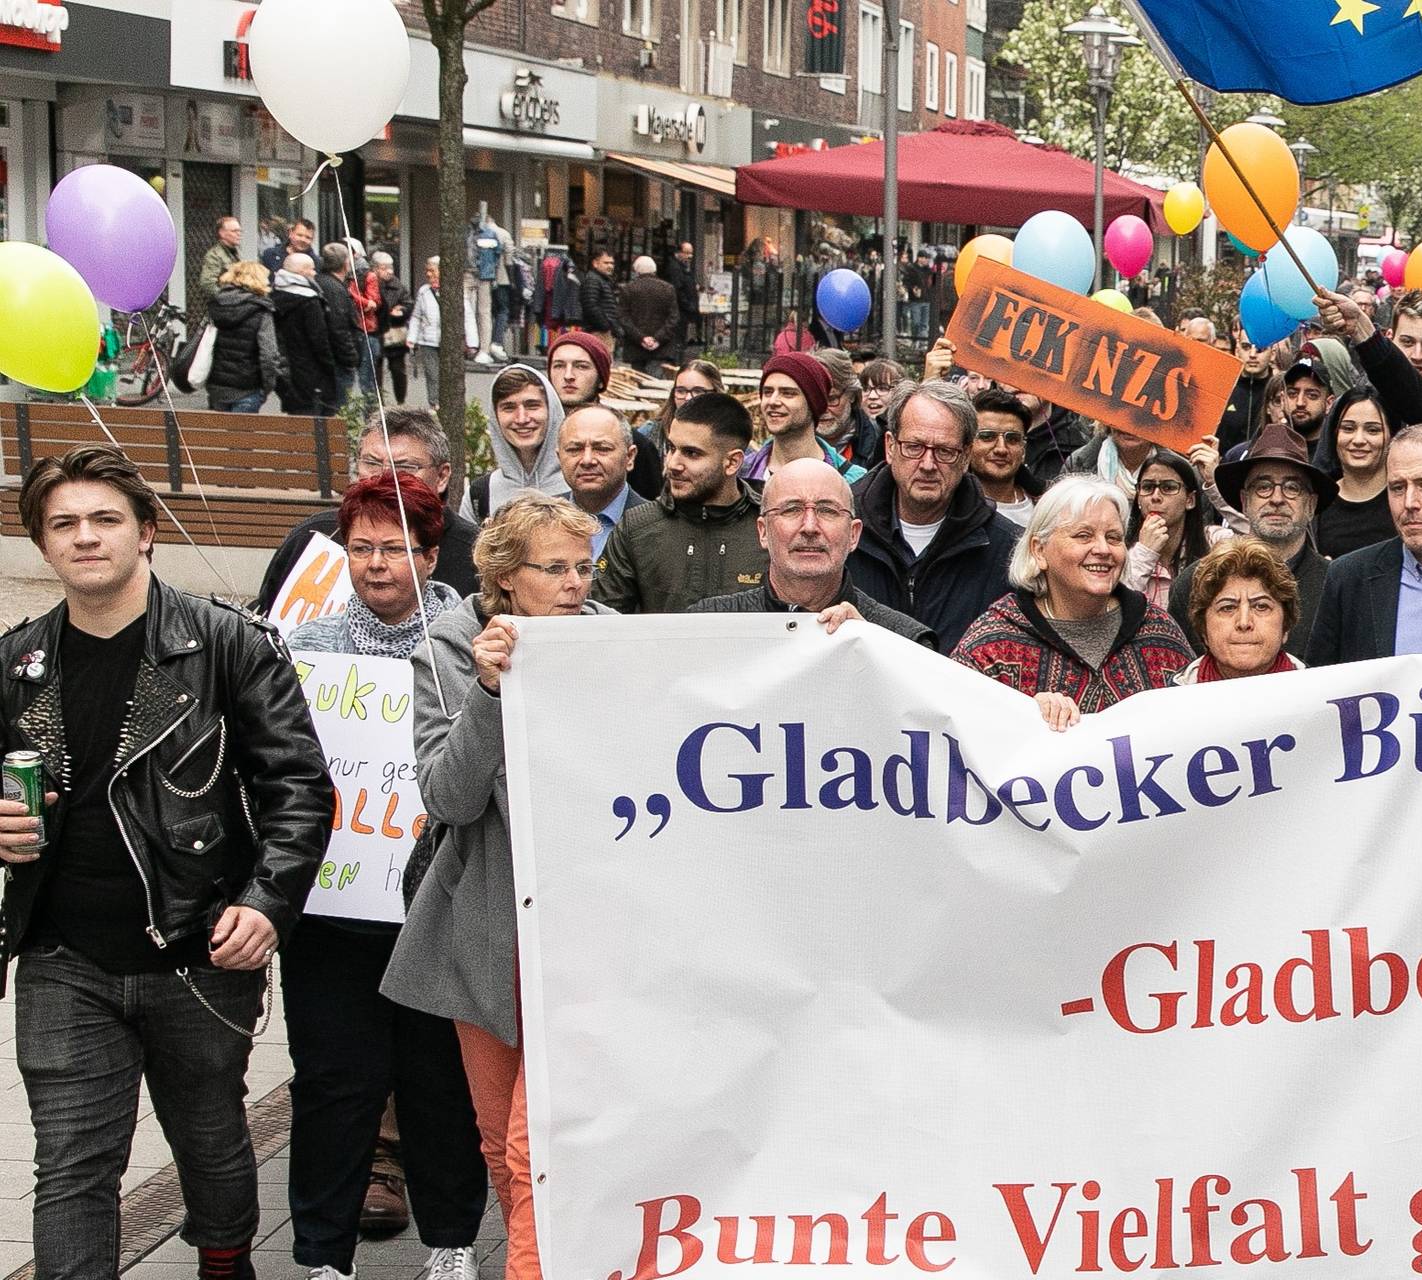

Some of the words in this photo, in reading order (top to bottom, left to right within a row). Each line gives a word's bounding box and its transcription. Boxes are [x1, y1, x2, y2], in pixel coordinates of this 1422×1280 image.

[974, 291, 1080, 376] FCK
[1082, 335, 1193, 421] NZS
[328, 756, 368, 778] nur
[611, 721, 1296, 841] „Gladbecker
[608, 1190, 958, 1280] Bunte
[992, 1167, 1374, 1276] Vielfalt
